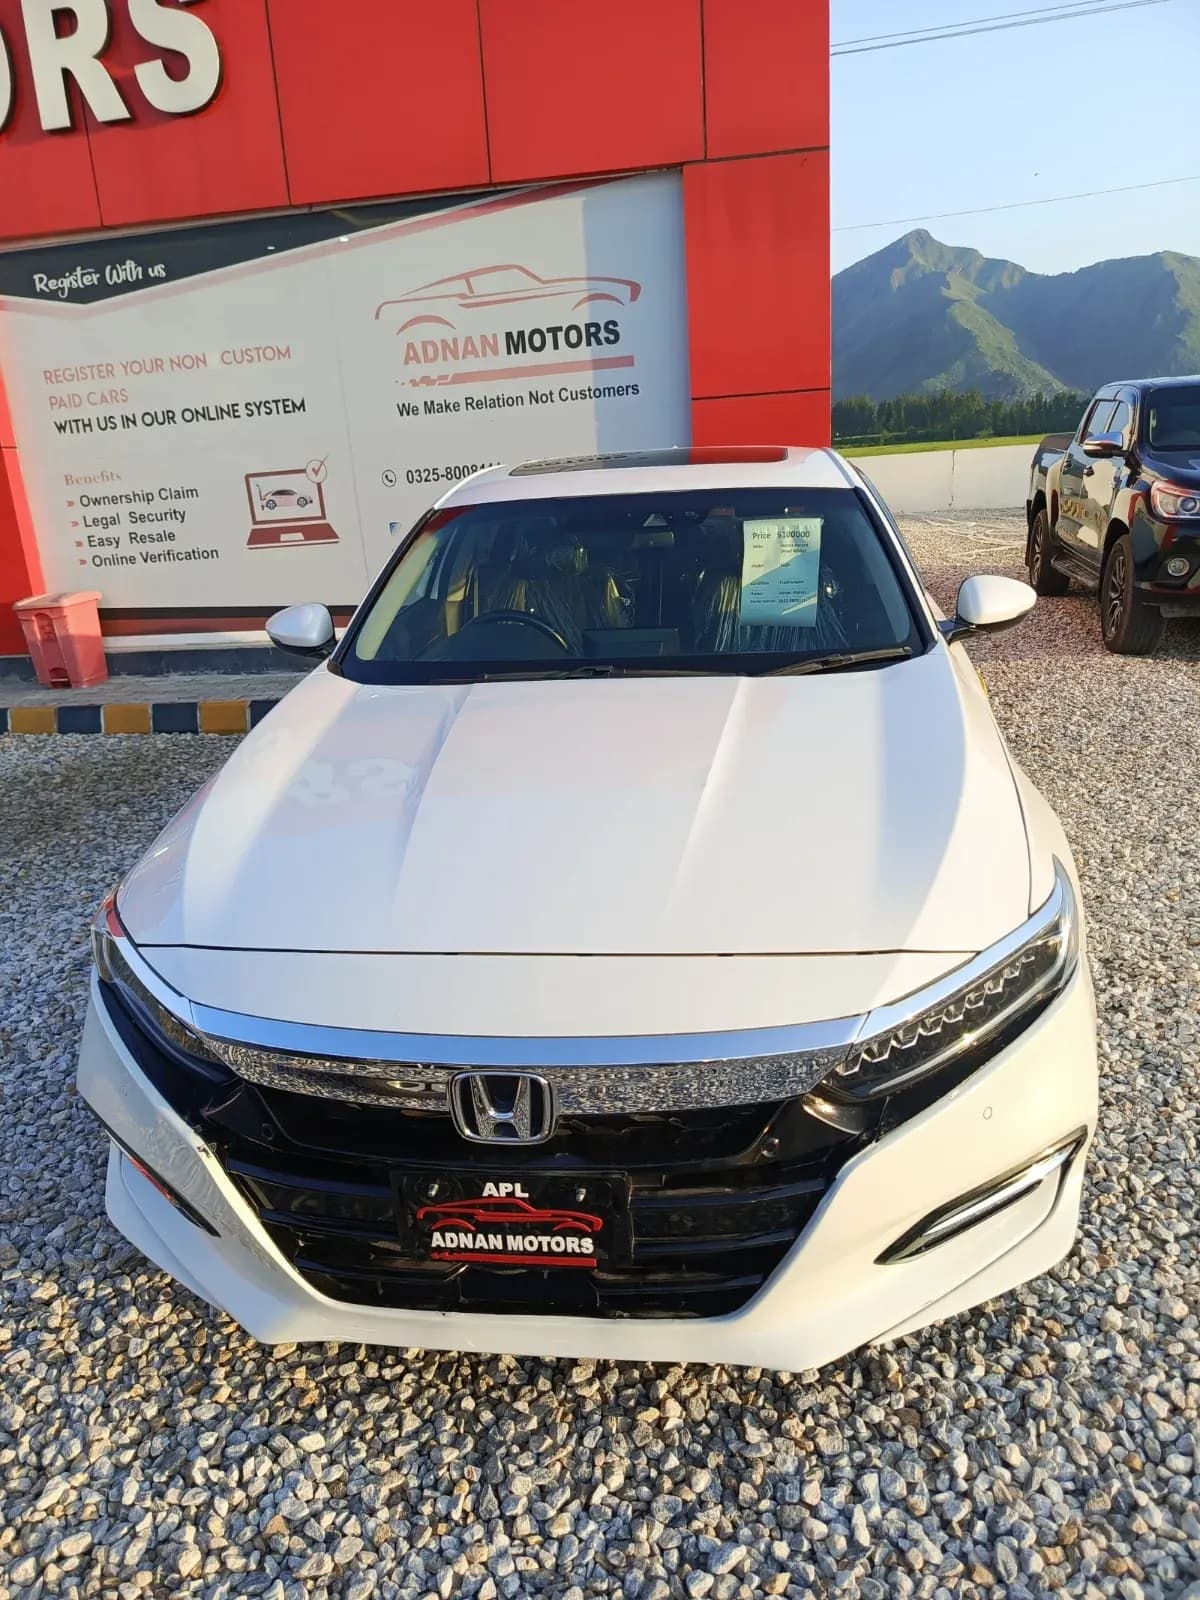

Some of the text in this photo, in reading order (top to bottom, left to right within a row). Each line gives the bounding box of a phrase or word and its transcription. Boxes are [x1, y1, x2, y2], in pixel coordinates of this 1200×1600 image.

[0, 0, 221, 132] RS
[33, 259, 167, 298] Register With us
[403, 319, 622, 366] ADNAN MOTORS
[43, 345, 292, 385] REGISTER YOUR NON CUSTOM
[48, 388, 129, 411] PAID CARS
[396, 382, 640, 418] We Make Relation Not Customers
[54, 397, 306, 435] WITH US IN OUR ONLINE SYSTEM
[63, 470, 122, 487] Benefits
[405, 461, 501, 484] 0325-8008
[79, 486, 199, 508] Ownership Claim
[83, 508, 187, 530] Legal Security
[87, 529, 176, 551] Easy Resale
[752, 531, 771, 539] Price
[91, 547, 220, 569] Online Verification
[481, 1182, 530, 1198] APL
[430, 1231, 595, 1255] ADNAN MOTORS
